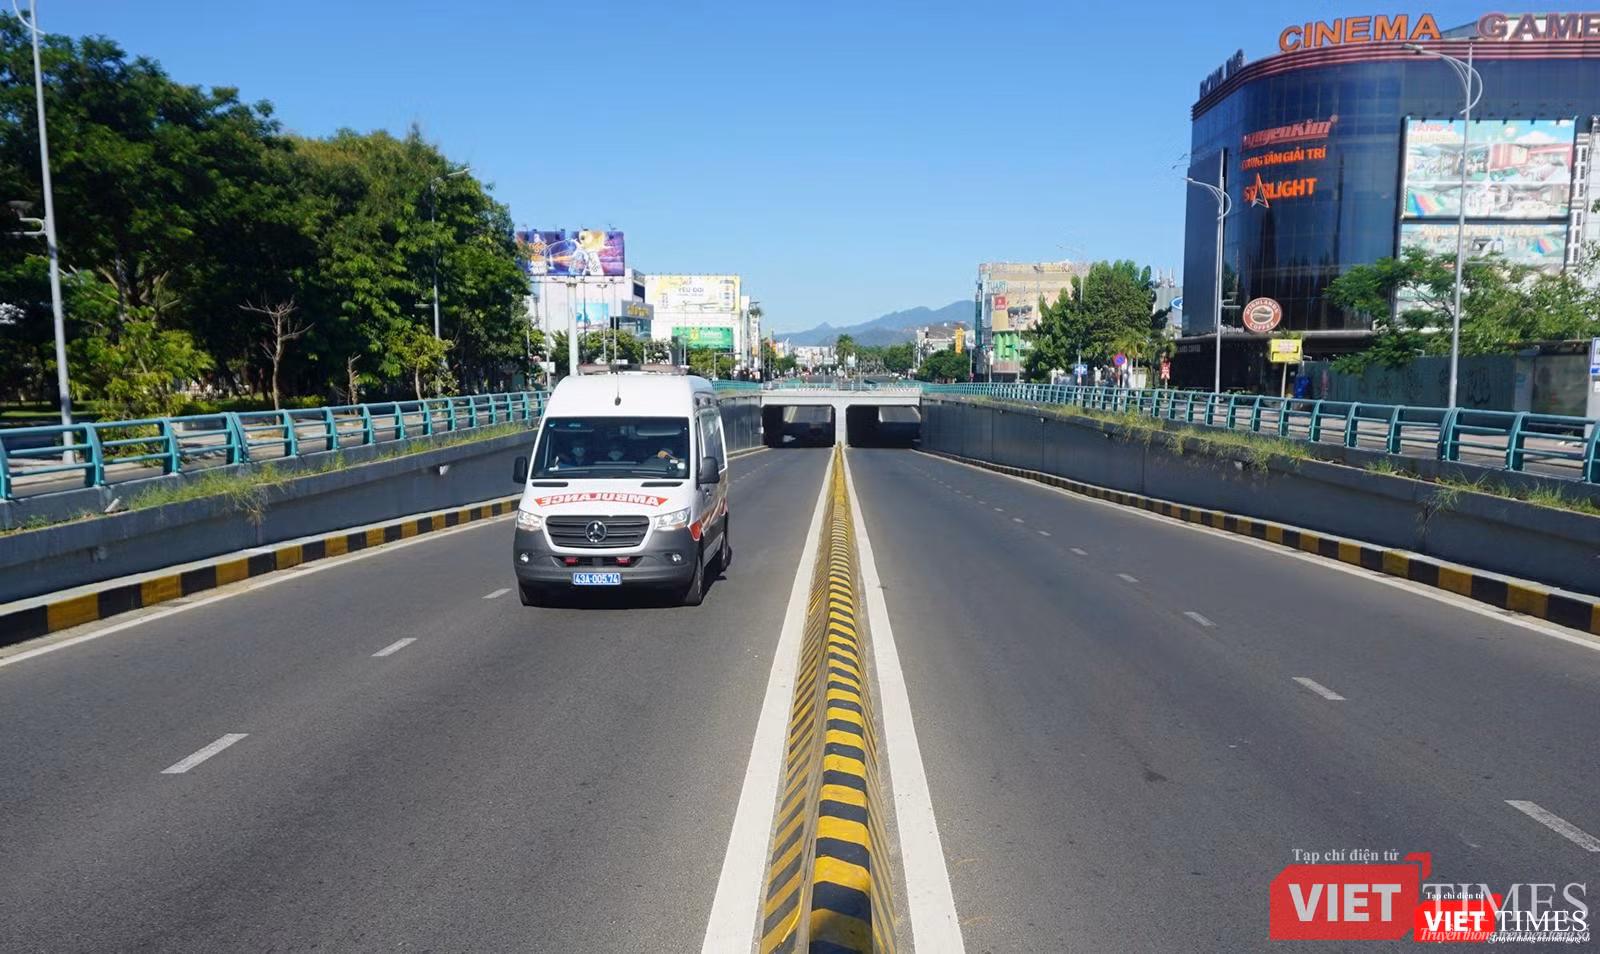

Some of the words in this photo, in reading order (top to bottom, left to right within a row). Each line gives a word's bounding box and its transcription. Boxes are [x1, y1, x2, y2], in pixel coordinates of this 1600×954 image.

[1279, 13, 1442, 53] CINEMA
[1476, 11, 1600, 40] GAME
[1307, 144, 1327, 160] TRÍ
[1249, 321, 1275, 331] COFFEE
